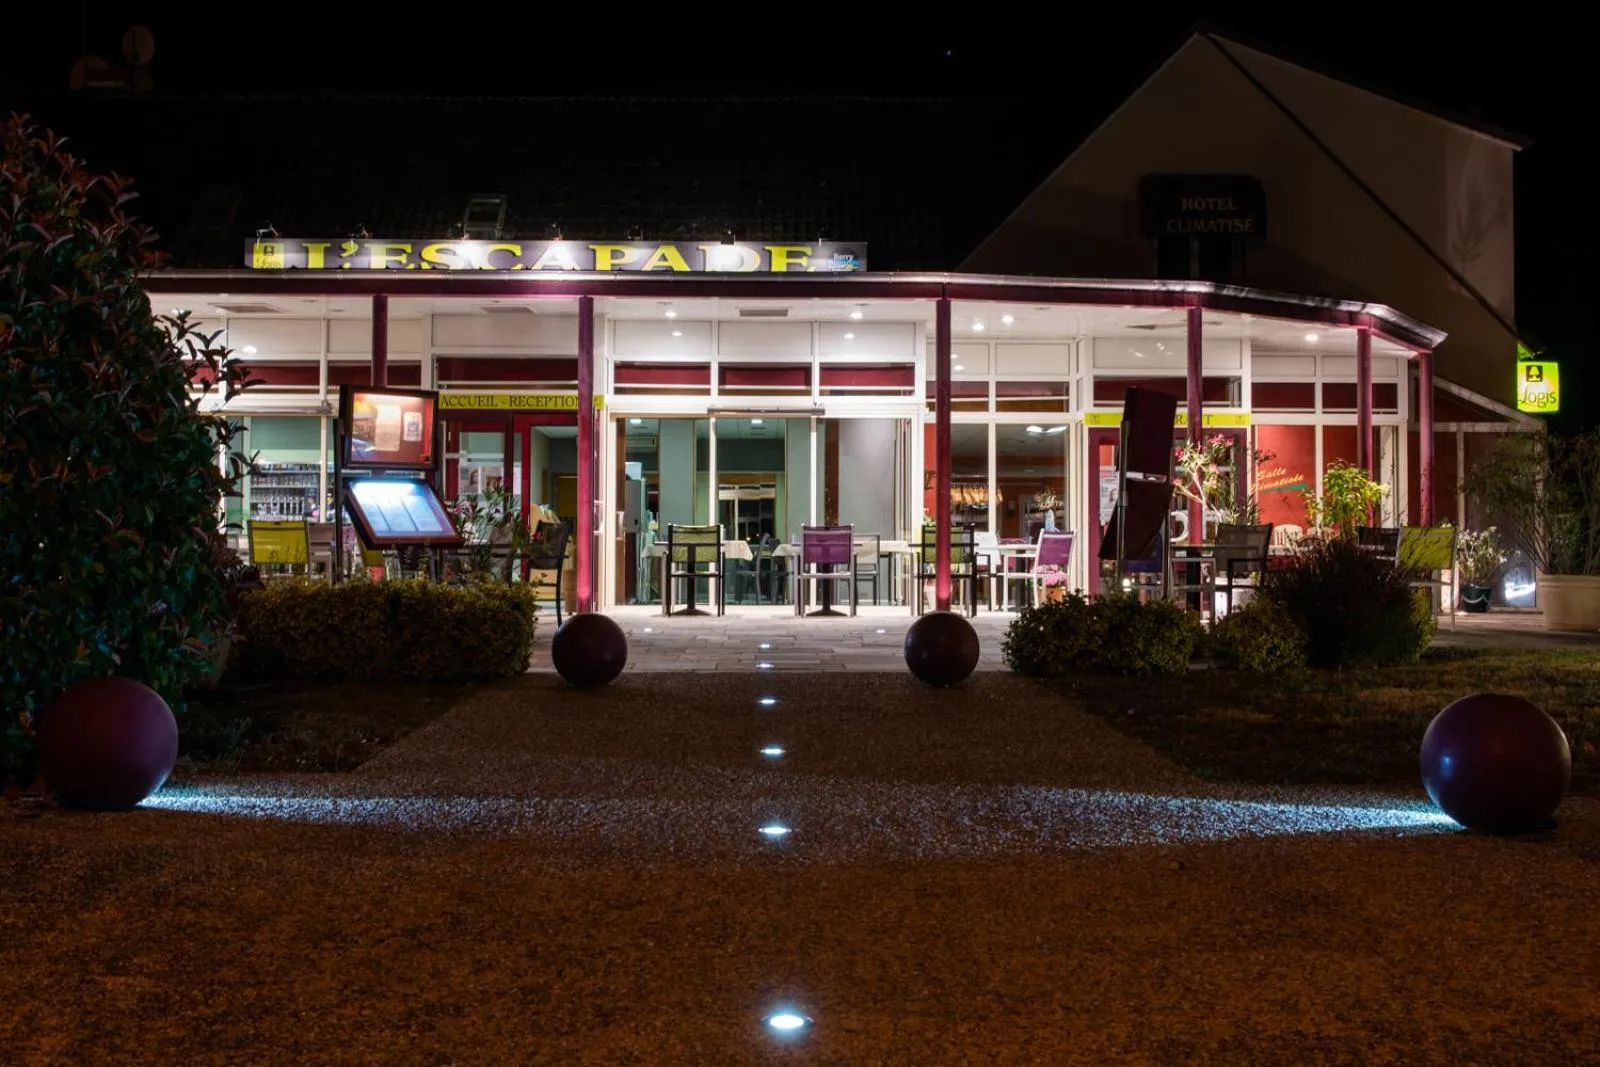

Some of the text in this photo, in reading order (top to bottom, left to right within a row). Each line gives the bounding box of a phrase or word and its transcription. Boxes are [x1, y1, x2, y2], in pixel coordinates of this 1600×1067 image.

[1181, 194, 1240, 212] HÔTEL
[440, 394, 498, 408] ACCUEIL
[509, 394, 579, 408] RECEPTIO
